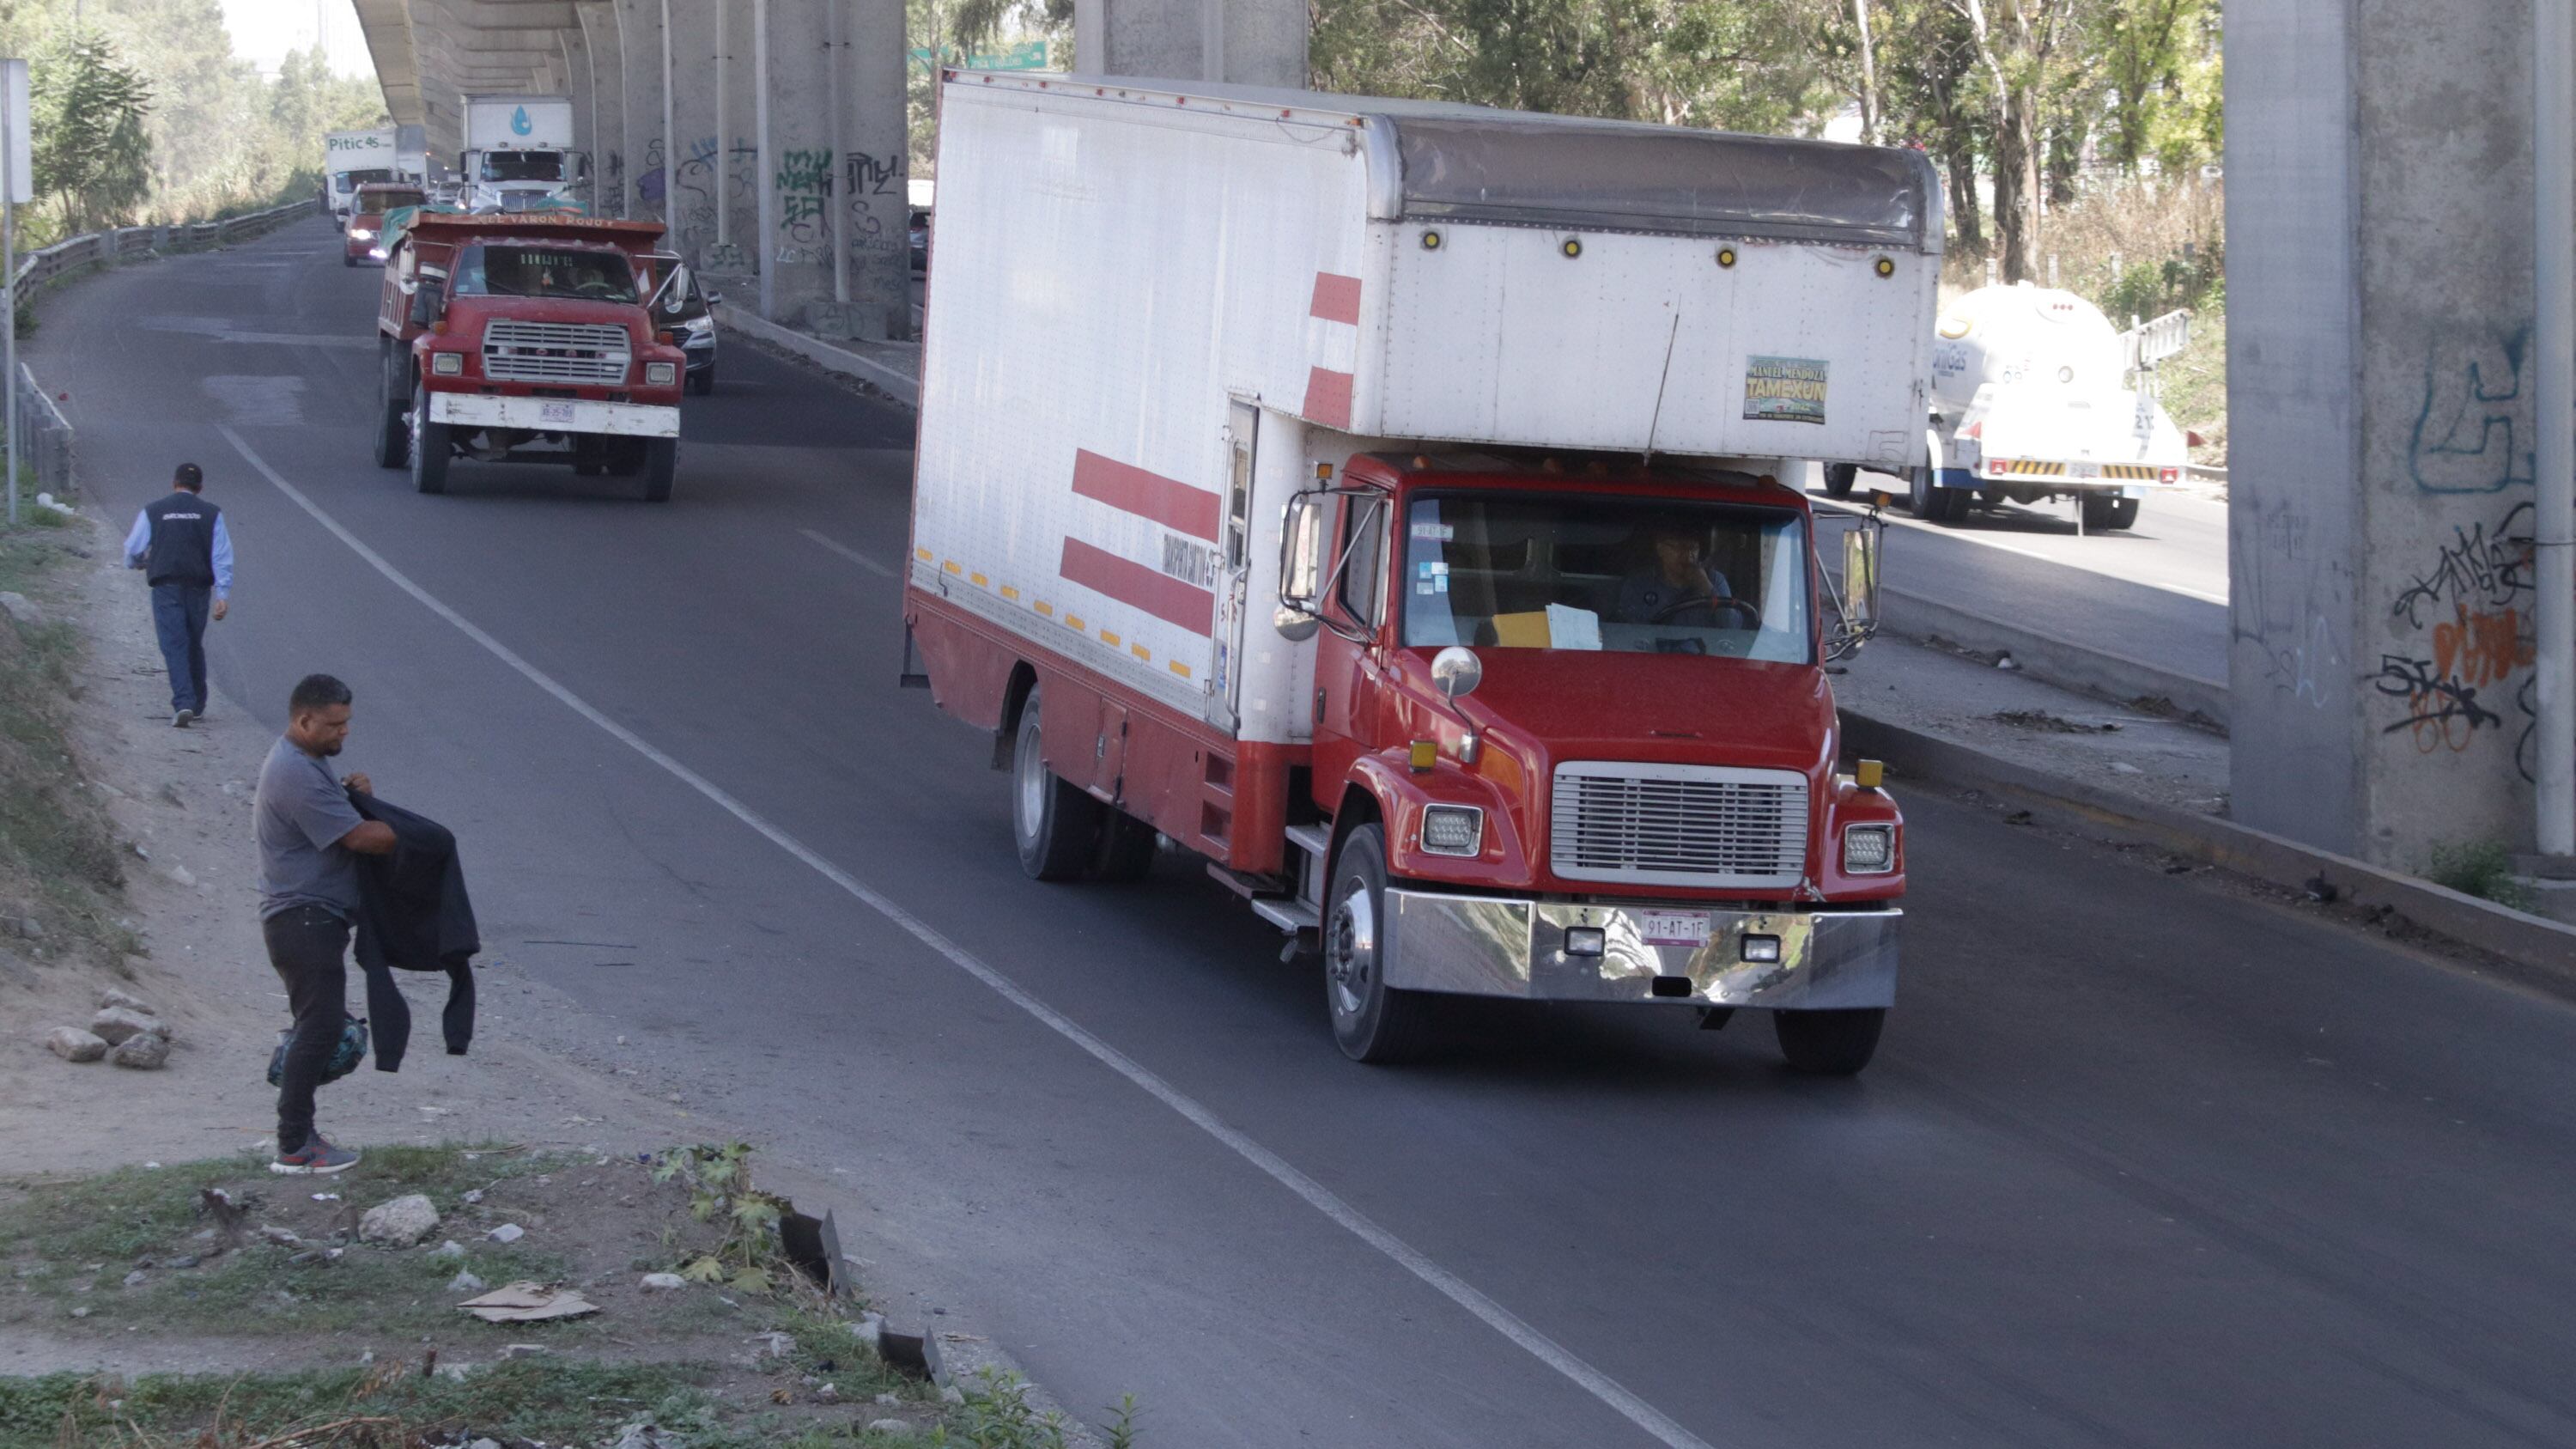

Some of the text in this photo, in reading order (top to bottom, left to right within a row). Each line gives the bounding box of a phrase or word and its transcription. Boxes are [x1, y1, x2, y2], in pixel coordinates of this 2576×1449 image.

[329, 137, 363, 151] Pitic
[510, 216, 557, 224] VARON
[566, 217, 603, 227] ROJO
[1750, 366, 1825, 381] MANUEL MENDOZA
[1747, 378, 1827, 401] TAMEXUN
[1648, 920, 1704, 937] 91-AT-1F
